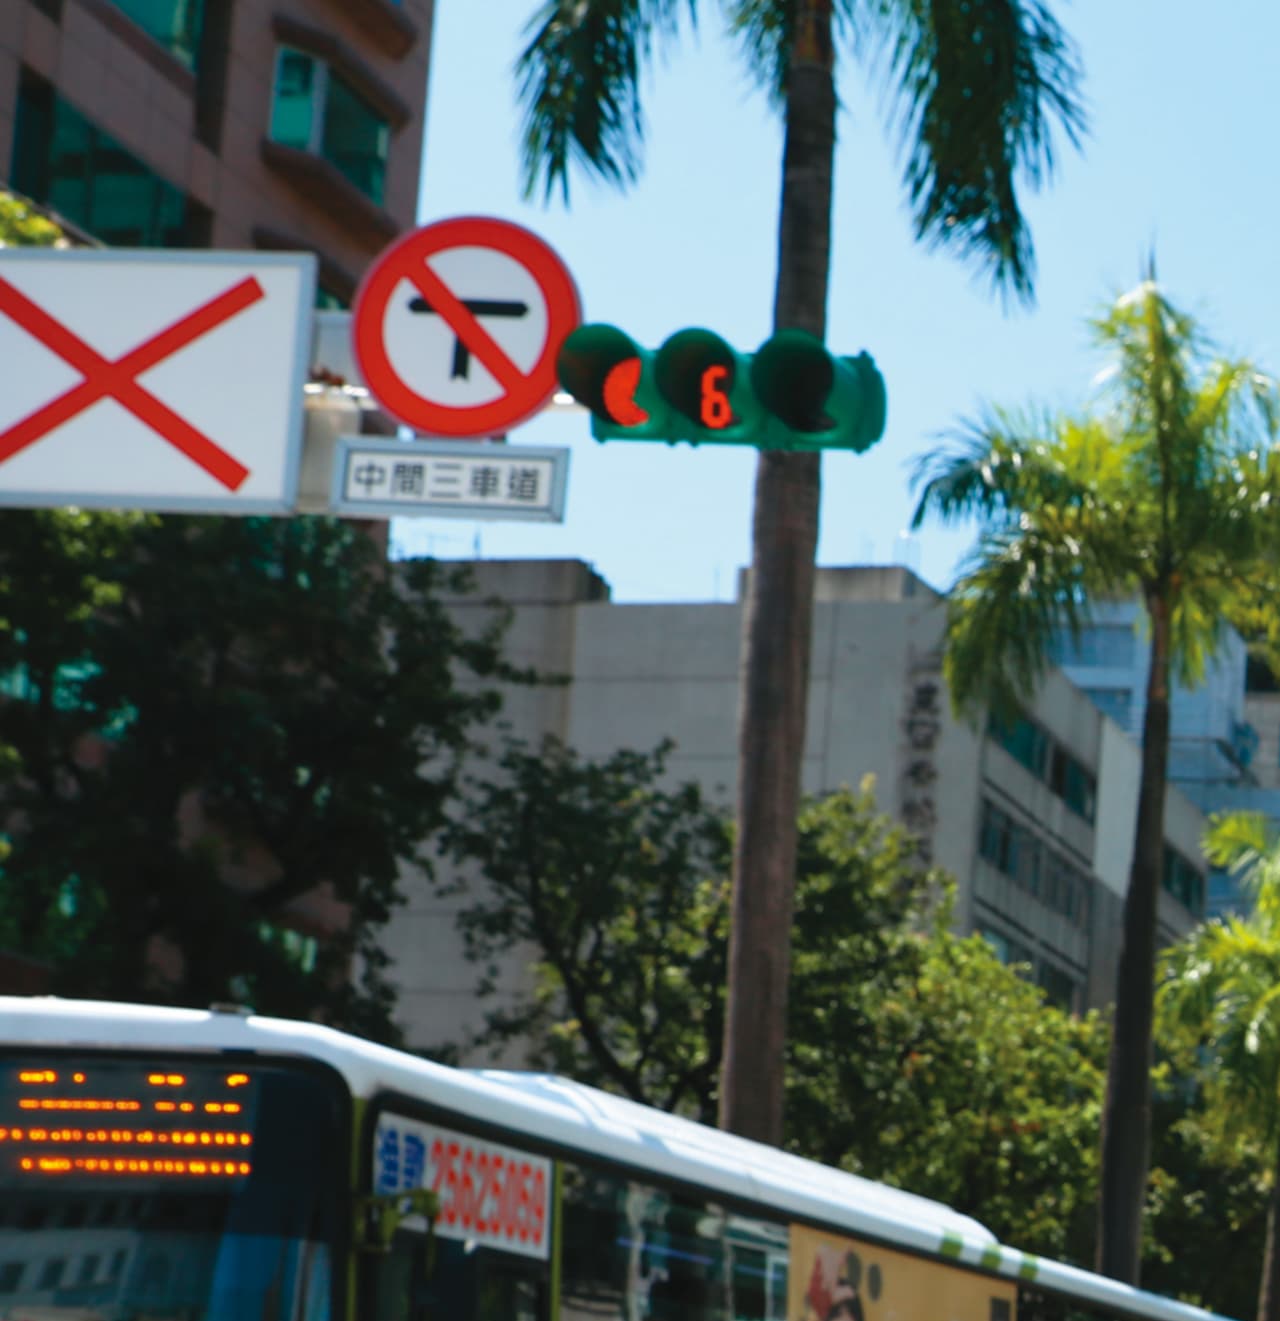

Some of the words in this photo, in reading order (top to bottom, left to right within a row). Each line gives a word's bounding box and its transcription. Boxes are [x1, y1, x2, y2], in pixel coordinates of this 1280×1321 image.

[354, 463, 540, 501] 中間三車道
